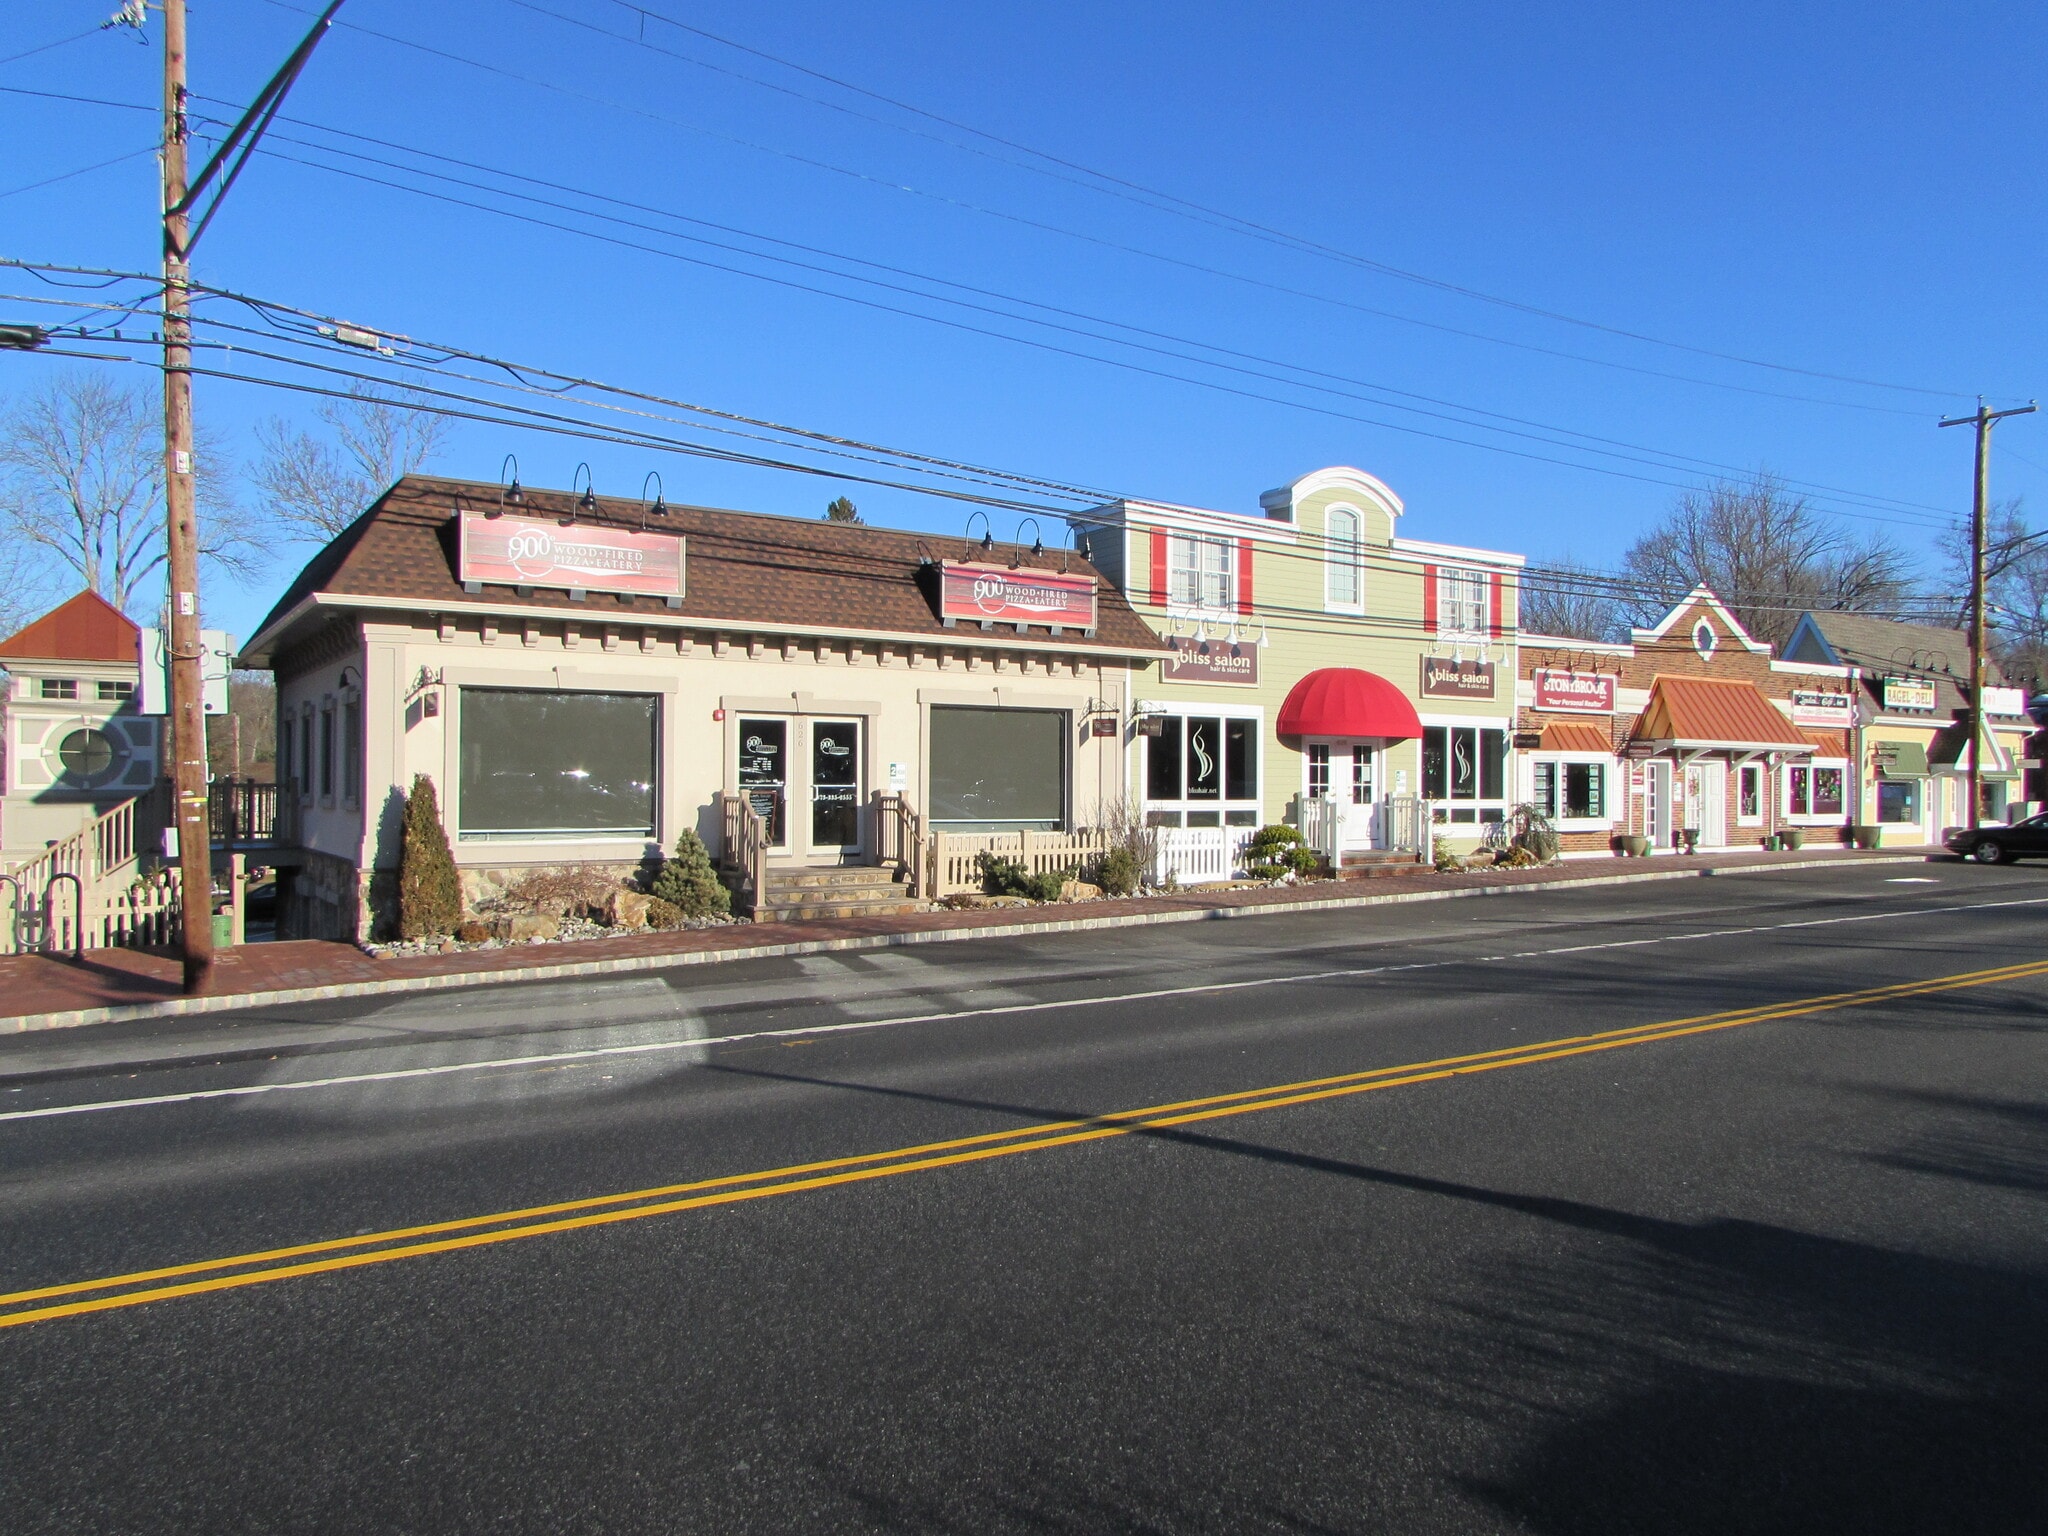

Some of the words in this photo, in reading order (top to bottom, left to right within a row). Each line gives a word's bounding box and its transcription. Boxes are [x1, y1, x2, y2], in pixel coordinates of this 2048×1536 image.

[1179, 648, 1210, 665] bliss
[1215, 652, 1250, 668] salon
[1435, 668, 1459, 682] bliss
[1462, 671, 1489, 684] salon
[1887, 689, 1911, 703] BAGEL
[1915, 691, 1932, 705] DELI
